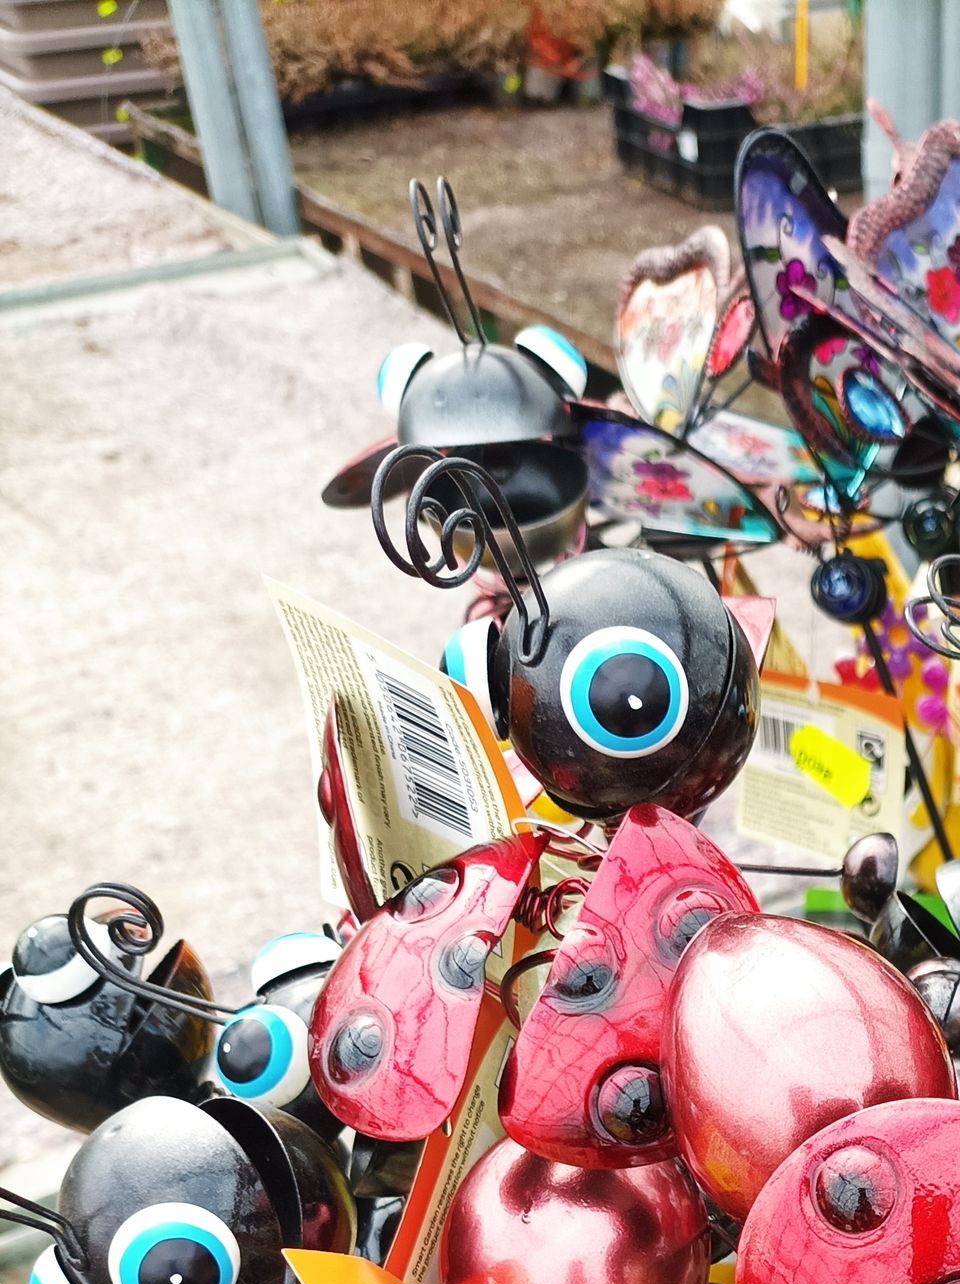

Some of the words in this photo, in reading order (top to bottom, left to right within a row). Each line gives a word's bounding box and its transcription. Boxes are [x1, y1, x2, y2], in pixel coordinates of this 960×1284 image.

[458, 759, 478, 812] 5031053
[411, 1246, 425, 1276] Smart
[423, 1210, 439, 1245] Garden
[437, 1169, 453, 1209] reserves
[450, 1151, 459, 1168] the
[456, 1129, 466, 1152] right
[462, 1118, 470, 1129] to
[467, 1084, 480, 1118] change
[416, 1265, 426, 1282] the
[424, 1226, 440, 1266] product
[460, 1129, 475, 1165] without
[472, 1100, 484, 1129] notice
